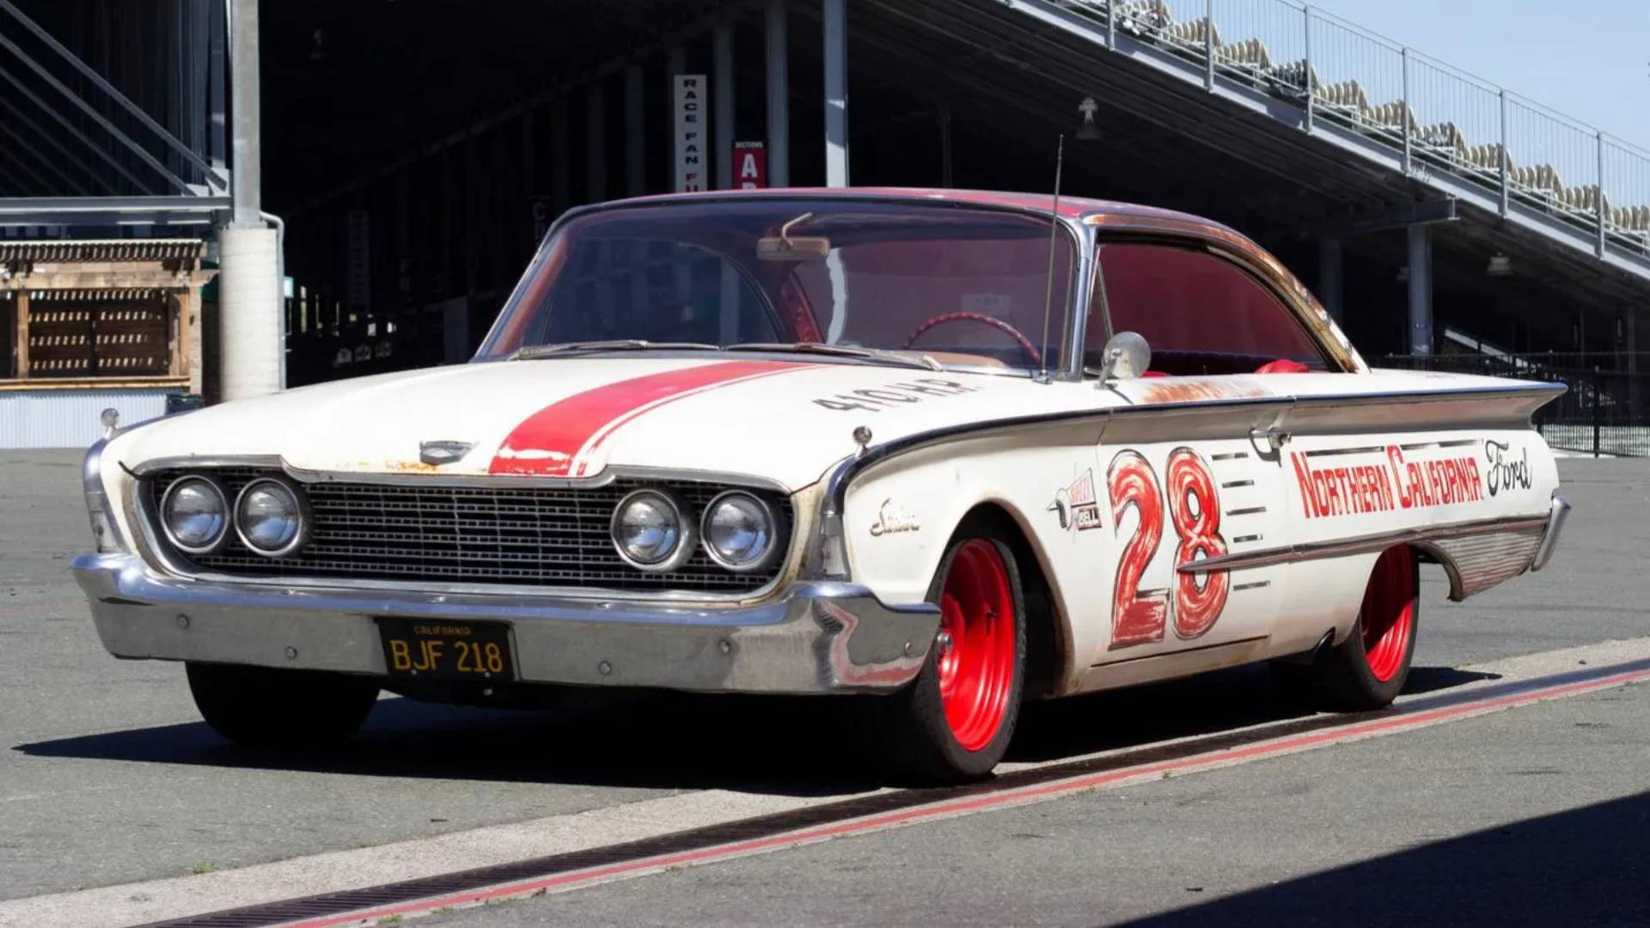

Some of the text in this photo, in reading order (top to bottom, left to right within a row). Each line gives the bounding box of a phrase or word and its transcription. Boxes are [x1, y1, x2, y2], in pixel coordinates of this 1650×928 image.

[683, 79, 697, 123] RACE
[685, 132, 699, 165] FAN
[741, 153, 758, 178] A
[812, 389, 922, 413] 410
[1290, 439, 1533, 519] NORTHERN CALIFORNIA Ford
[1107, 446, 1231, 647] 28
[389, 640, 503, 673] BJF 218
